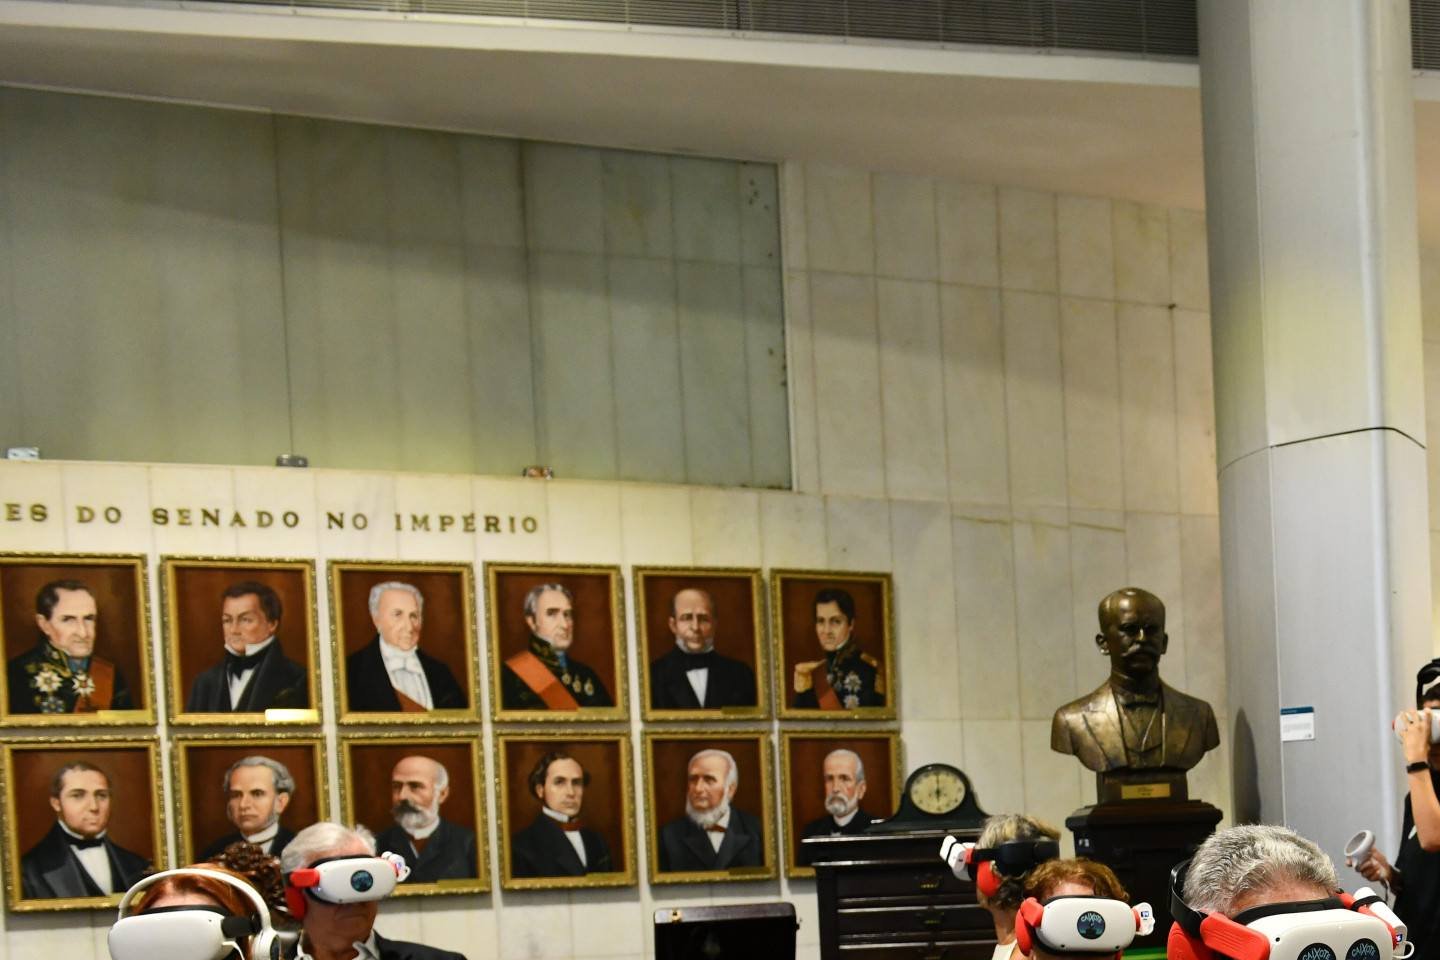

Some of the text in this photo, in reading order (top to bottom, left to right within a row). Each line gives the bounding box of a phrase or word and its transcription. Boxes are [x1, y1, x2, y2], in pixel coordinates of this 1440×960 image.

[76, 505, 122, 524] DO
[151, 507, 300, 529] SENADO
[326, 511, 369, 531] NO
[394, 511, 538, 534] IMPÉRIO
